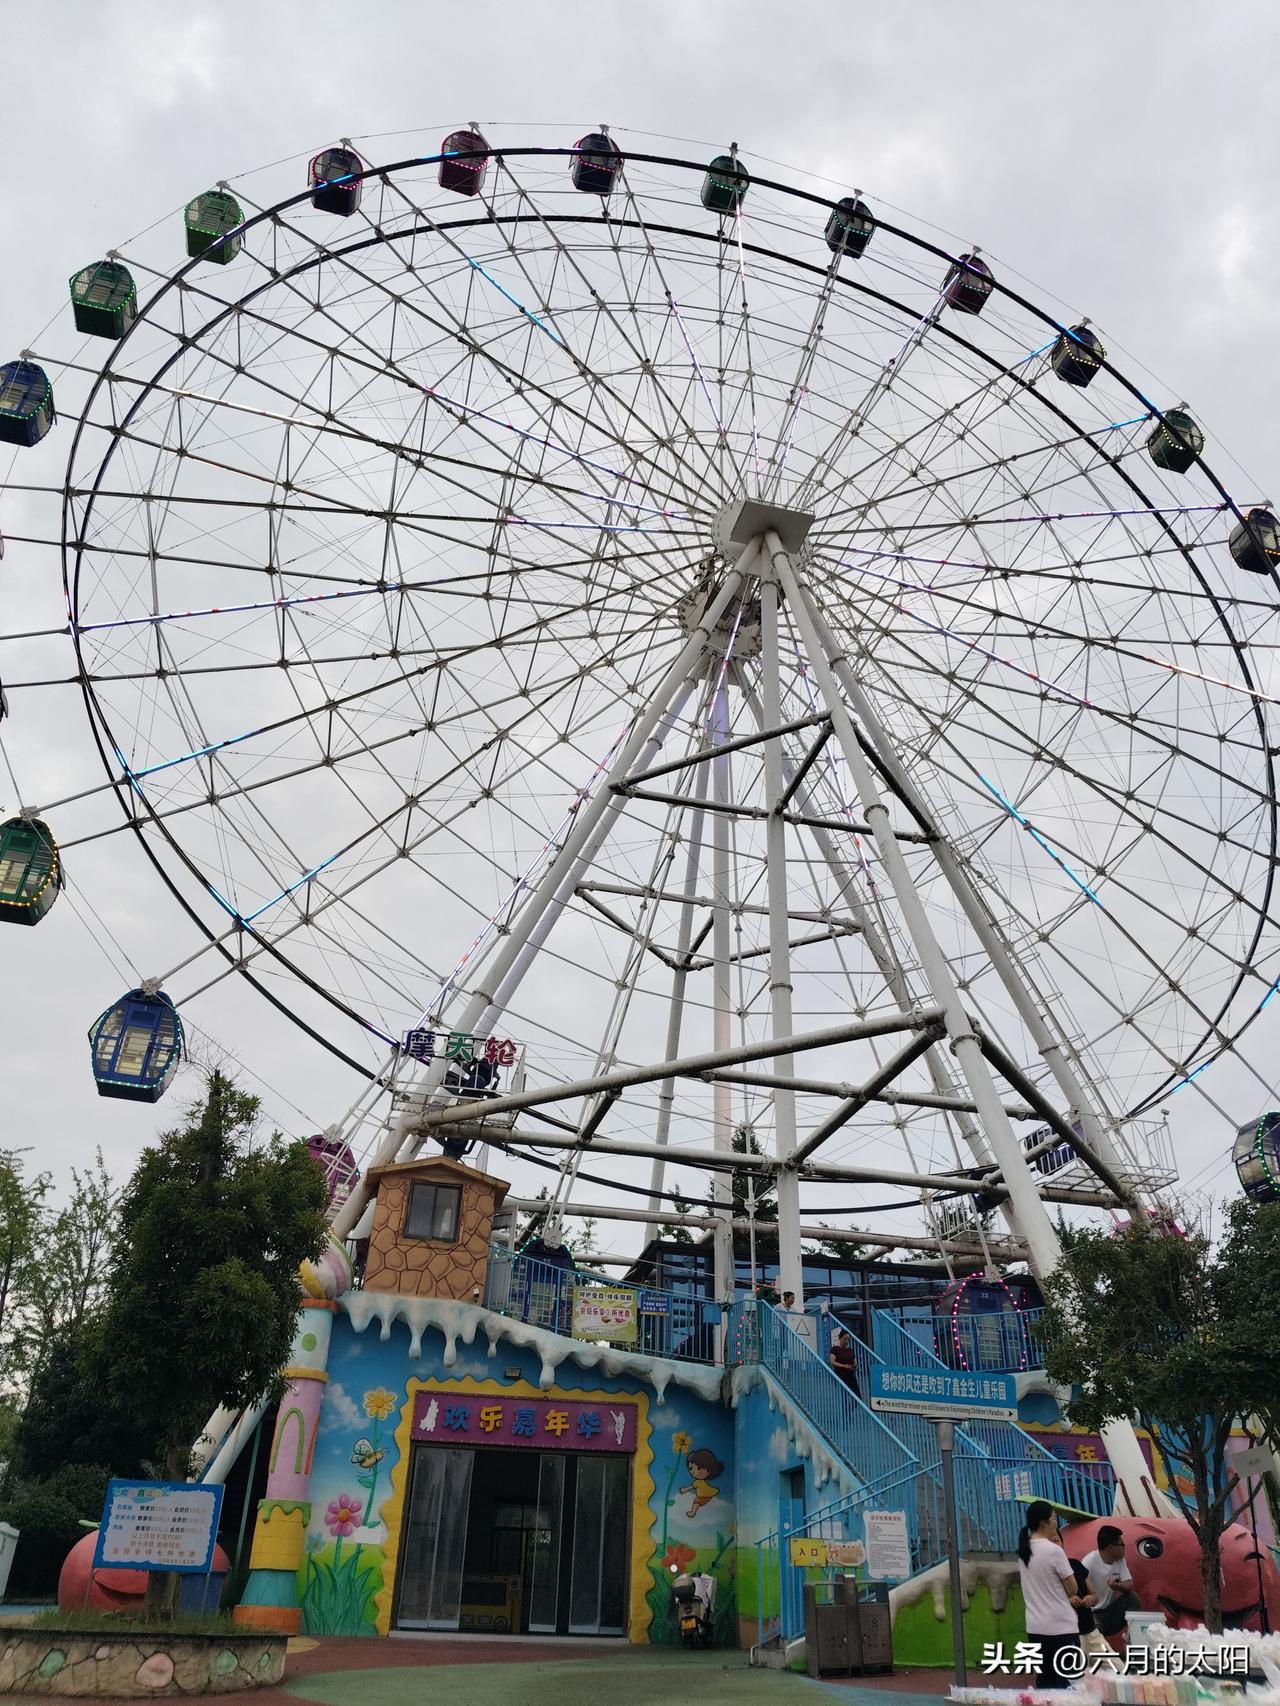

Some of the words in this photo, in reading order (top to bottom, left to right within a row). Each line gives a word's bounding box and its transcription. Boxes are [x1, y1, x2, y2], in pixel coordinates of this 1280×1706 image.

[402, 1027, 517, 1067] 摩天轮
[882, 1371, 1007, 1401] 想你的风还是吹到了鑫金生儿童乐园
[442, 1404, 602, 1440] 欢乐嘉年华
[800, 1548, 818, 1556] 入口
